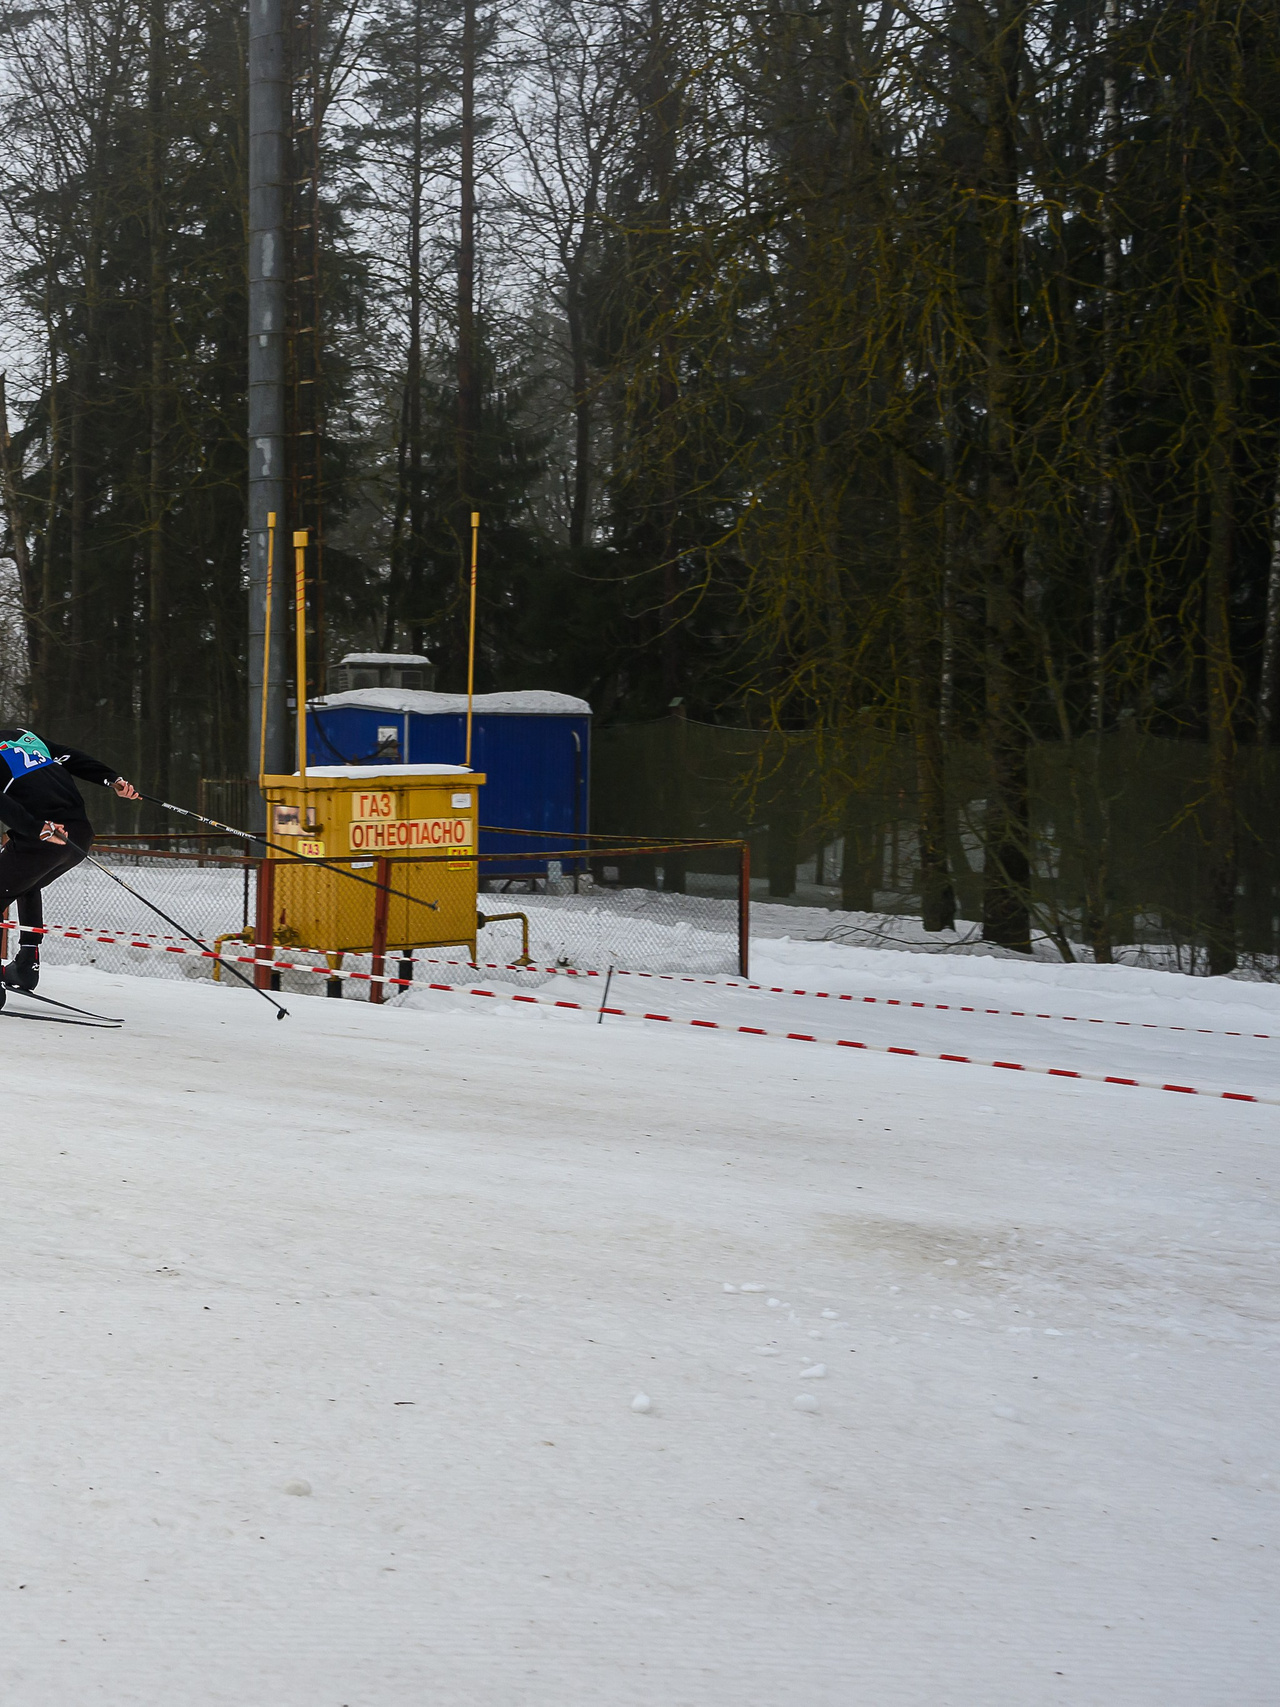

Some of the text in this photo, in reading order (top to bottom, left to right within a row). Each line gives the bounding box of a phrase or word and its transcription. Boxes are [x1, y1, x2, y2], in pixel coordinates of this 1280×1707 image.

[13, 746, 47, 769] 23
[360, 793, 392, 817] ГАЗ
[352, 820, 465, 848] ОГНЕОПАСНО
[302, 843, 320, 856] ГАЗ
